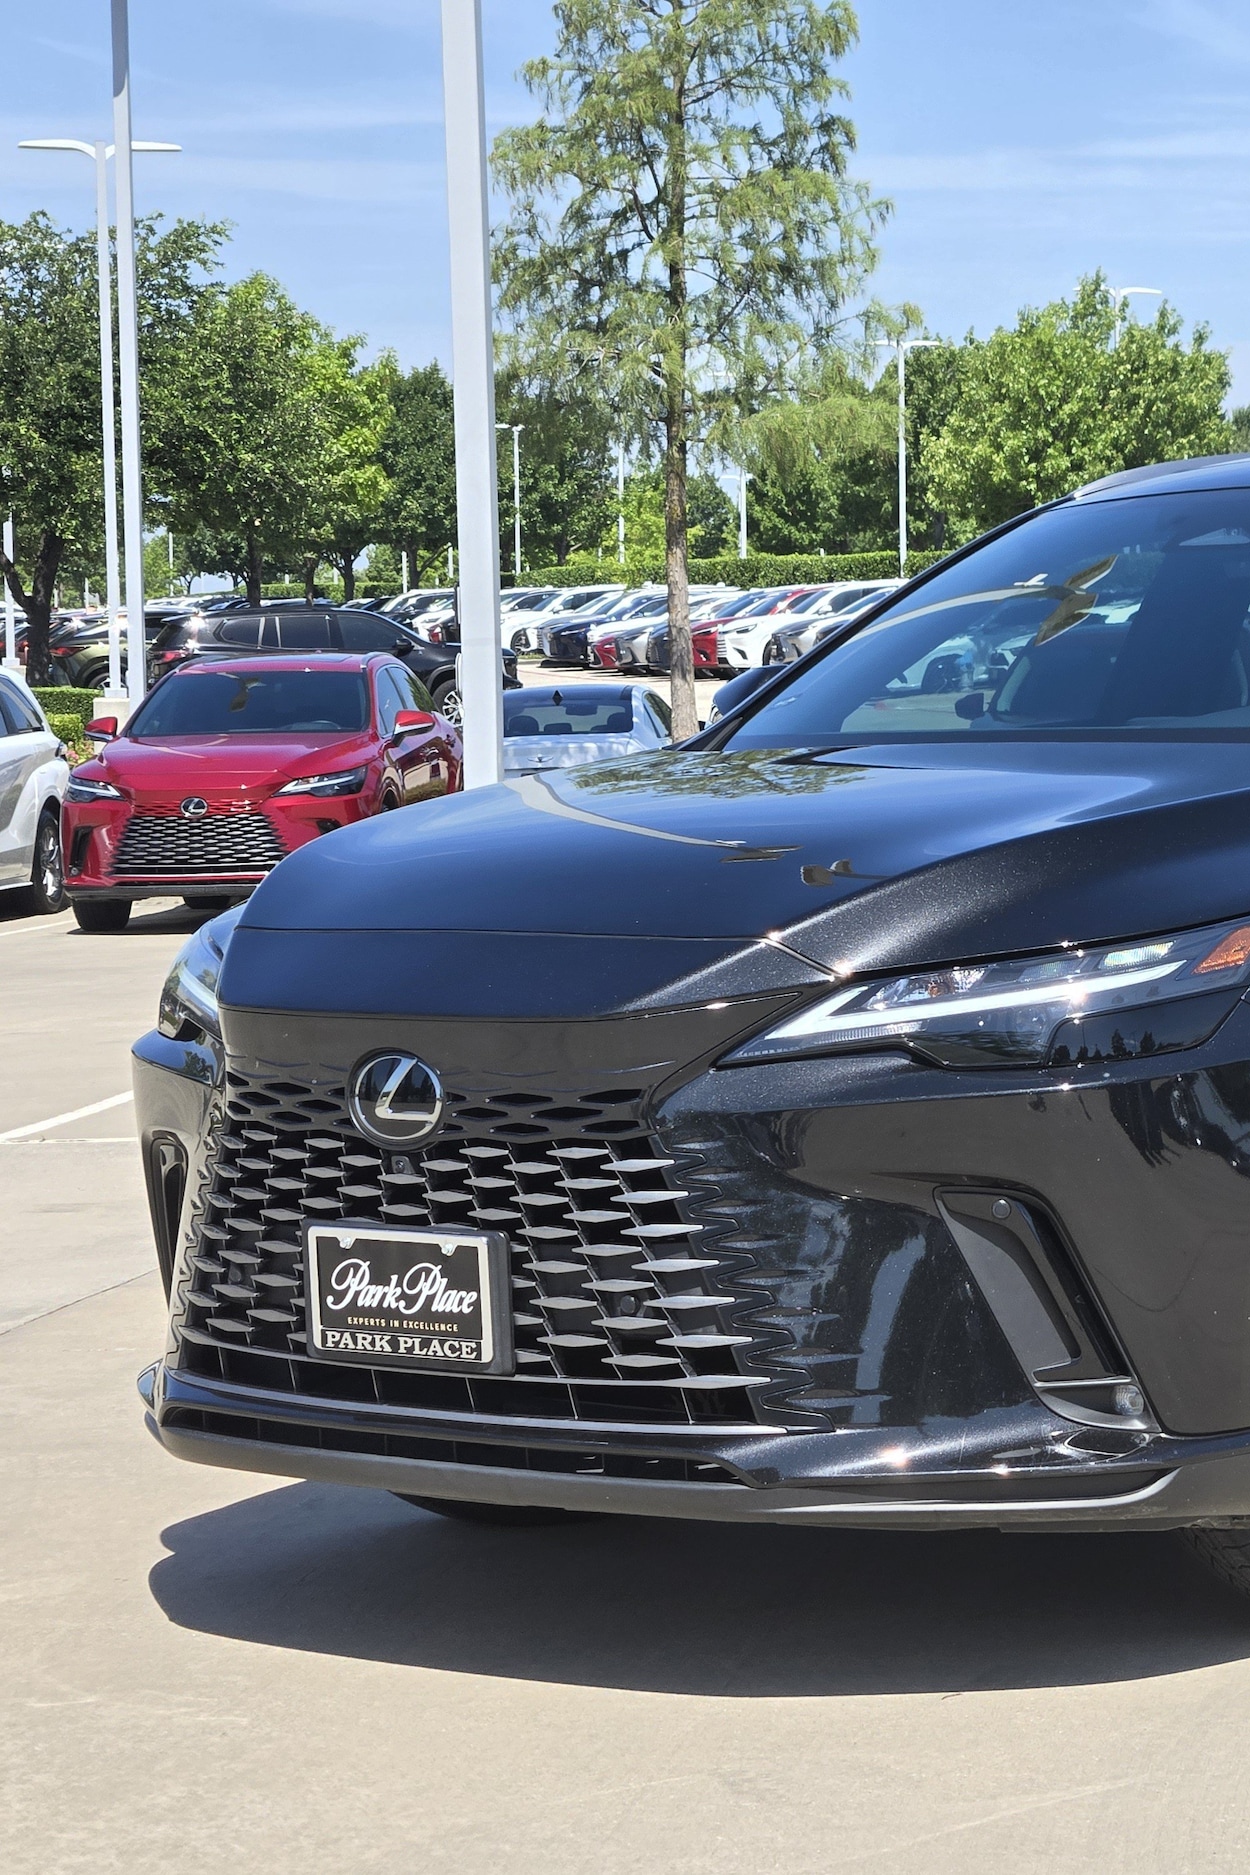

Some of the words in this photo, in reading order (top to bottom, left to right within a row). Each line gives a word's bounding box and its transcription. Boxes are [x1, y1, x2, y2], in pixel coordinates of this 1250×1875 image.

[326, 1258, 402, 1310] Park
[399, 1262, 478, 1315] Place
[347, 1316, 386, 1328] EXPERTS
[389, 1319, 400, 1328] IN
[402, 1319, 459, 1333] EXCELLENCE
[325, 1330, 393, 1353] PARK
[397, 1336, 478, 1360] PLACE
